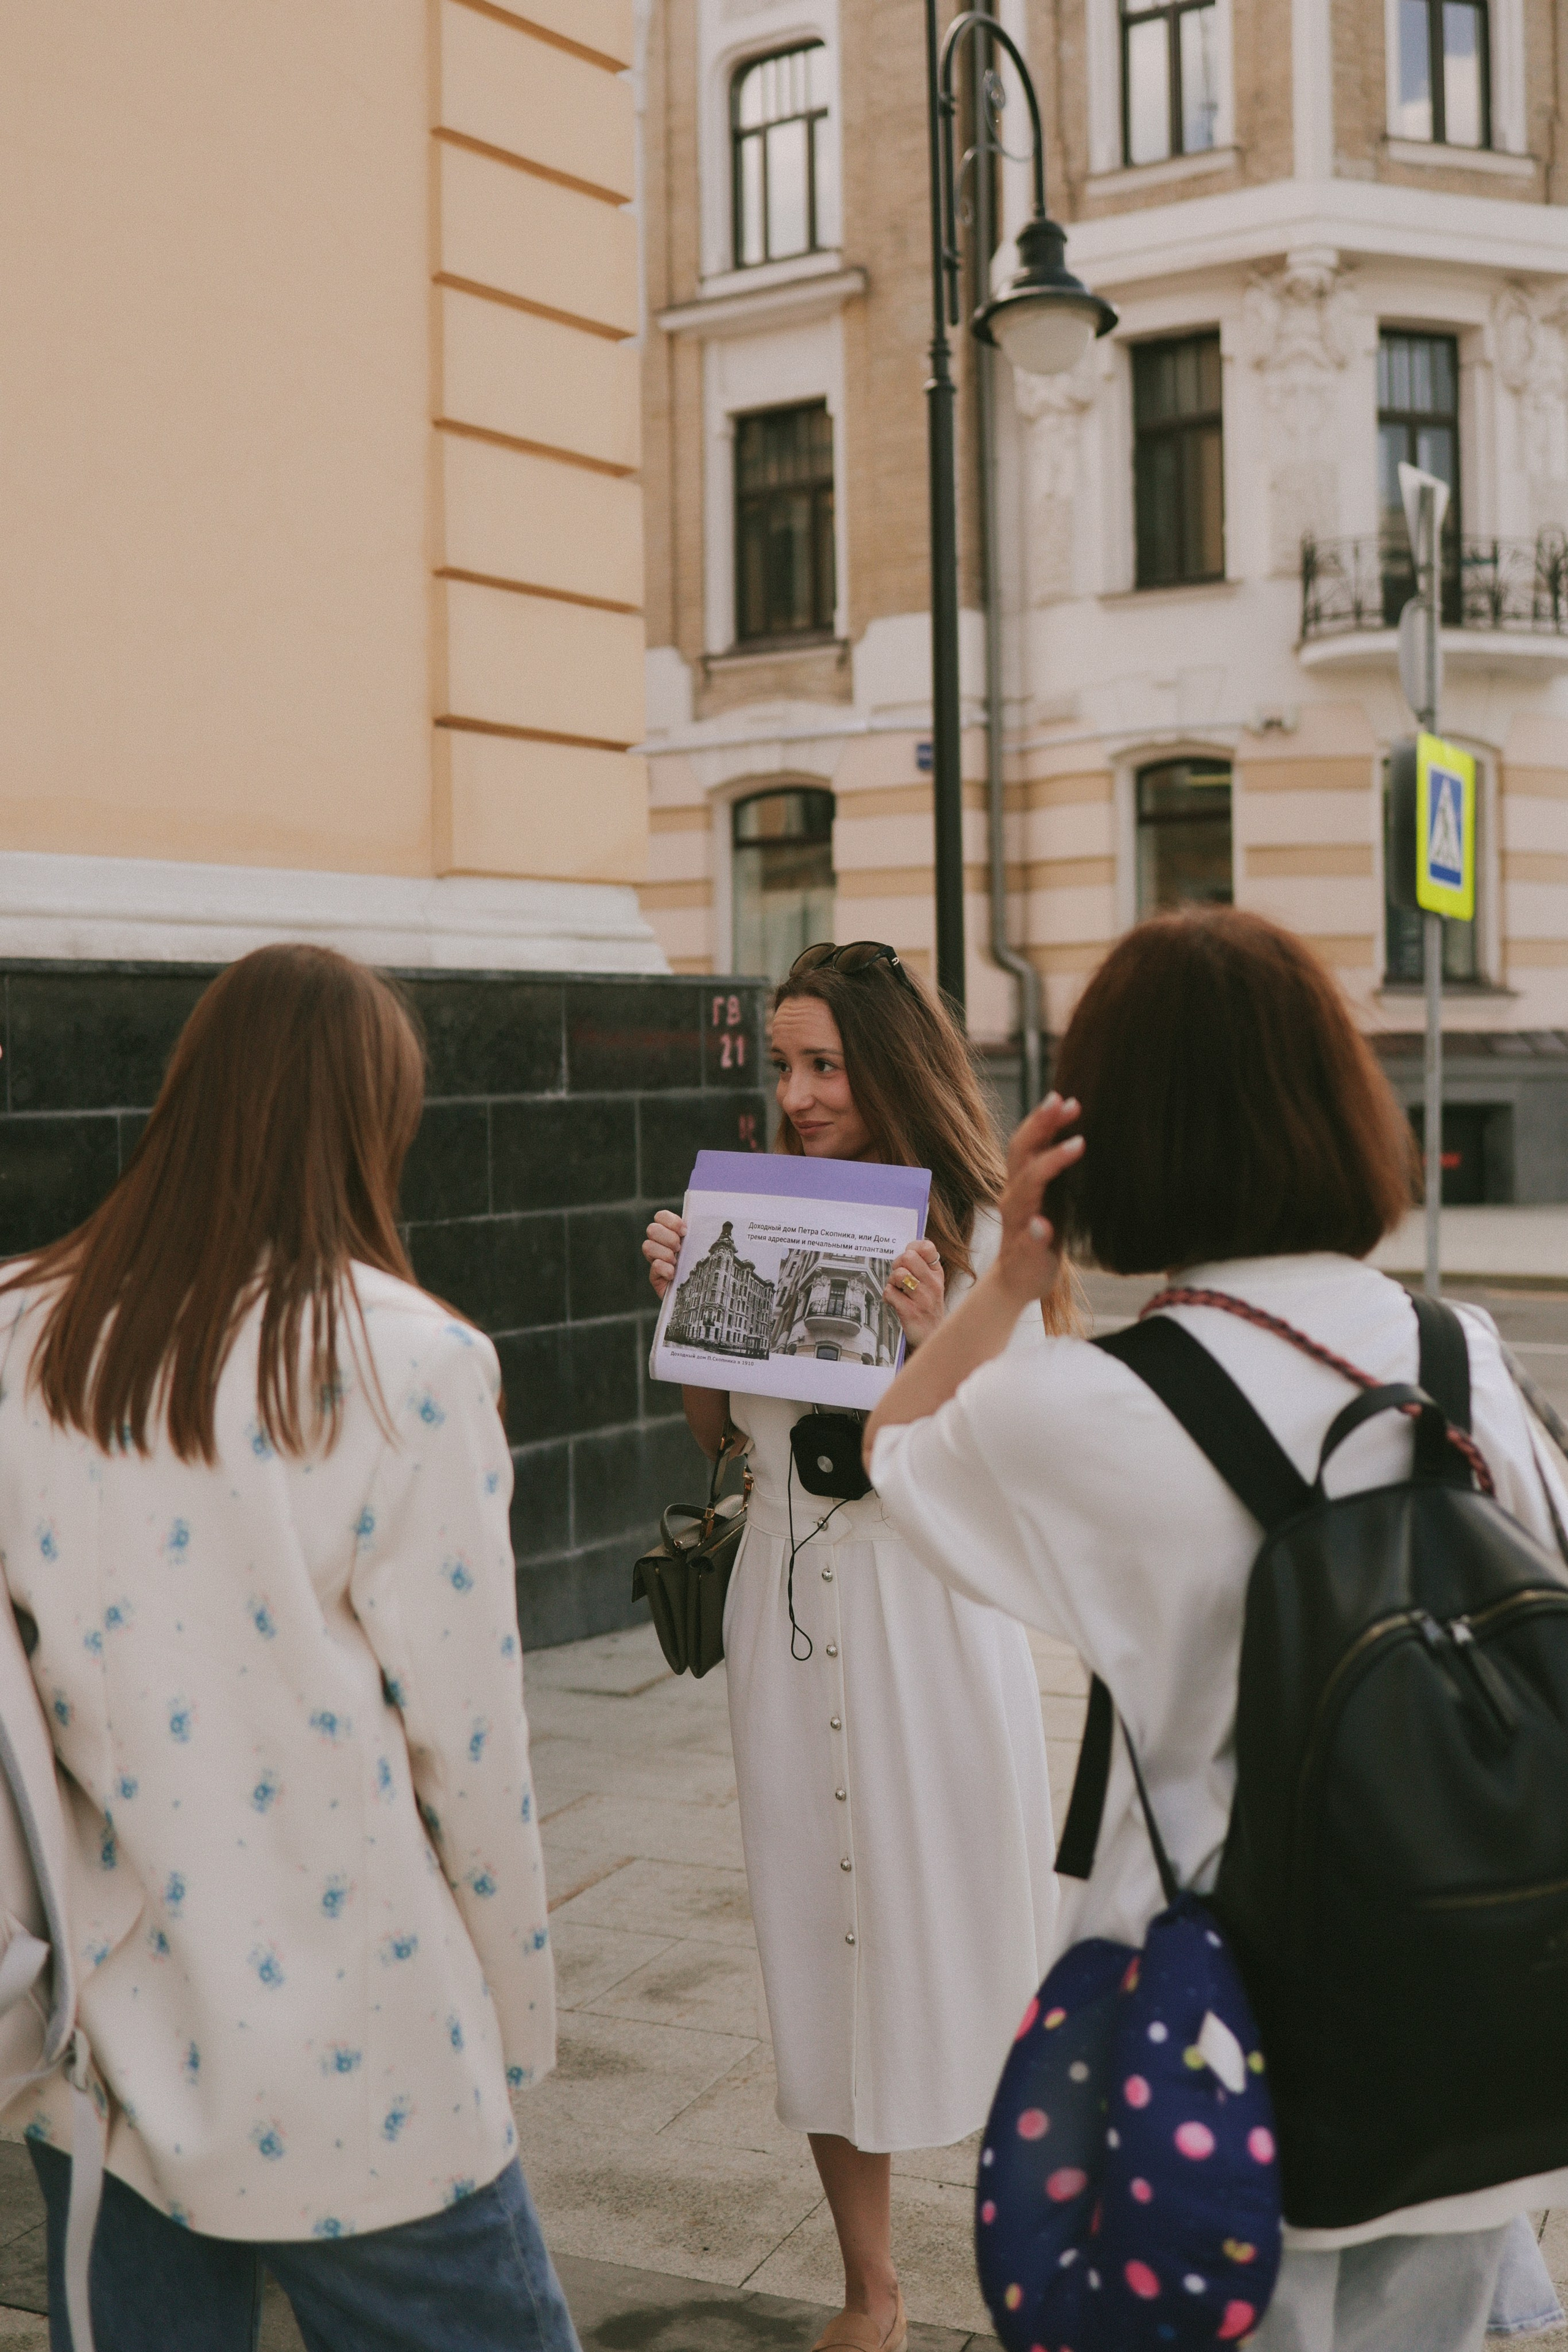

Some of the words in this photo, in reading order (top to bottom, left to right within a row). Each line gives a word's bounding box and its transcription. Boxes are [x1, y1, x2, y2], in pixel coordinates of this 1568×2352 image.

[720, 1033, 745, 1068] 21
[748, 1222, 781, 1231] Доходный
[798, 1227, 819, 1236] Петра
[821, 1229, 856, 1240] Скопника,
[807, 1240, 853, 1250] печальными
[854, 1245, 894, 1254] атлантами
